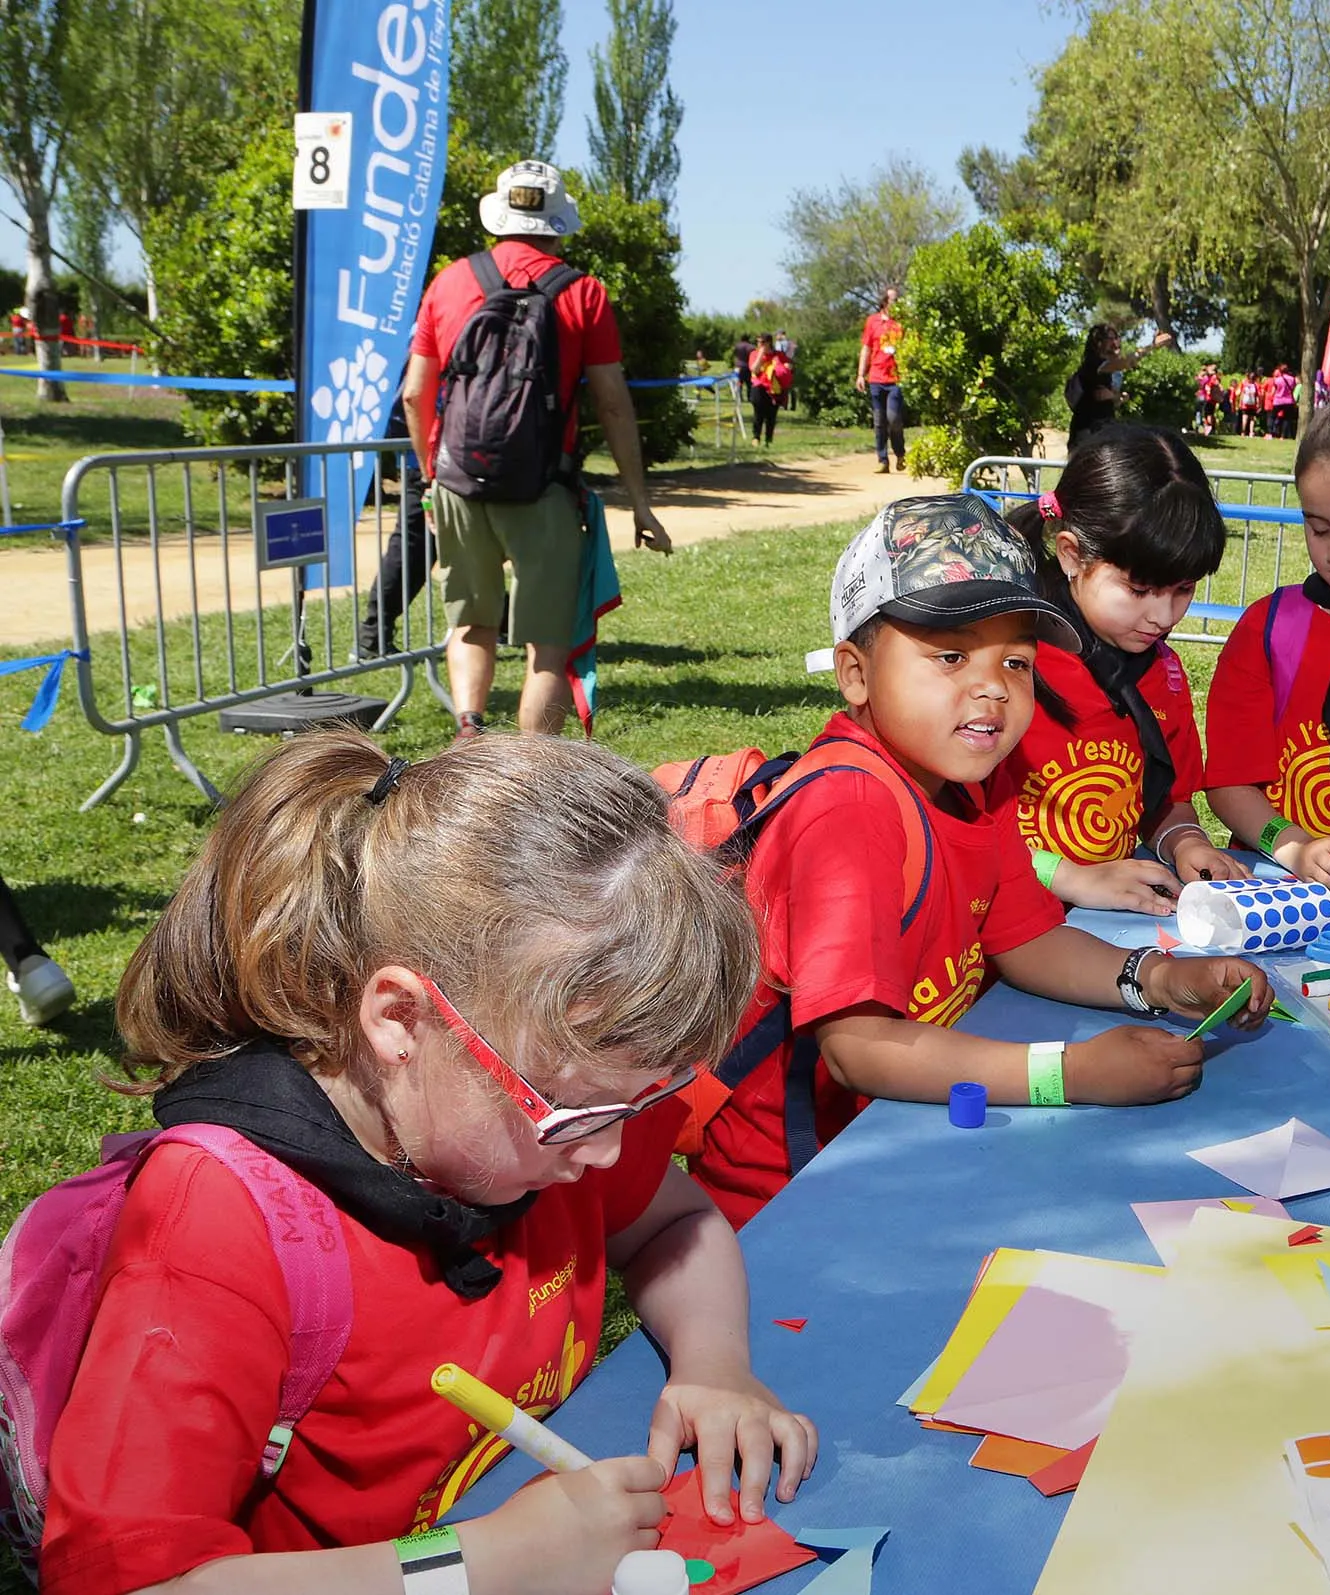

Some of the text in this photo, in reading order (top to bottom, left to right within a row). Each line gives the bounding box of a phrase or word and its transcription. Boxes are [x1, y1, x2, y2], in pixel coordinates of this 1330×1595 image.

[310, 146, 330, 185] 8
[337, 0, 430, 330] Funde
[379, 222, 422, 336] Fundació
[408, 109, 438, 217] Catalana
[423, 70, 442, 103] de
[1067, 739, 1142, 773] l'estiu
